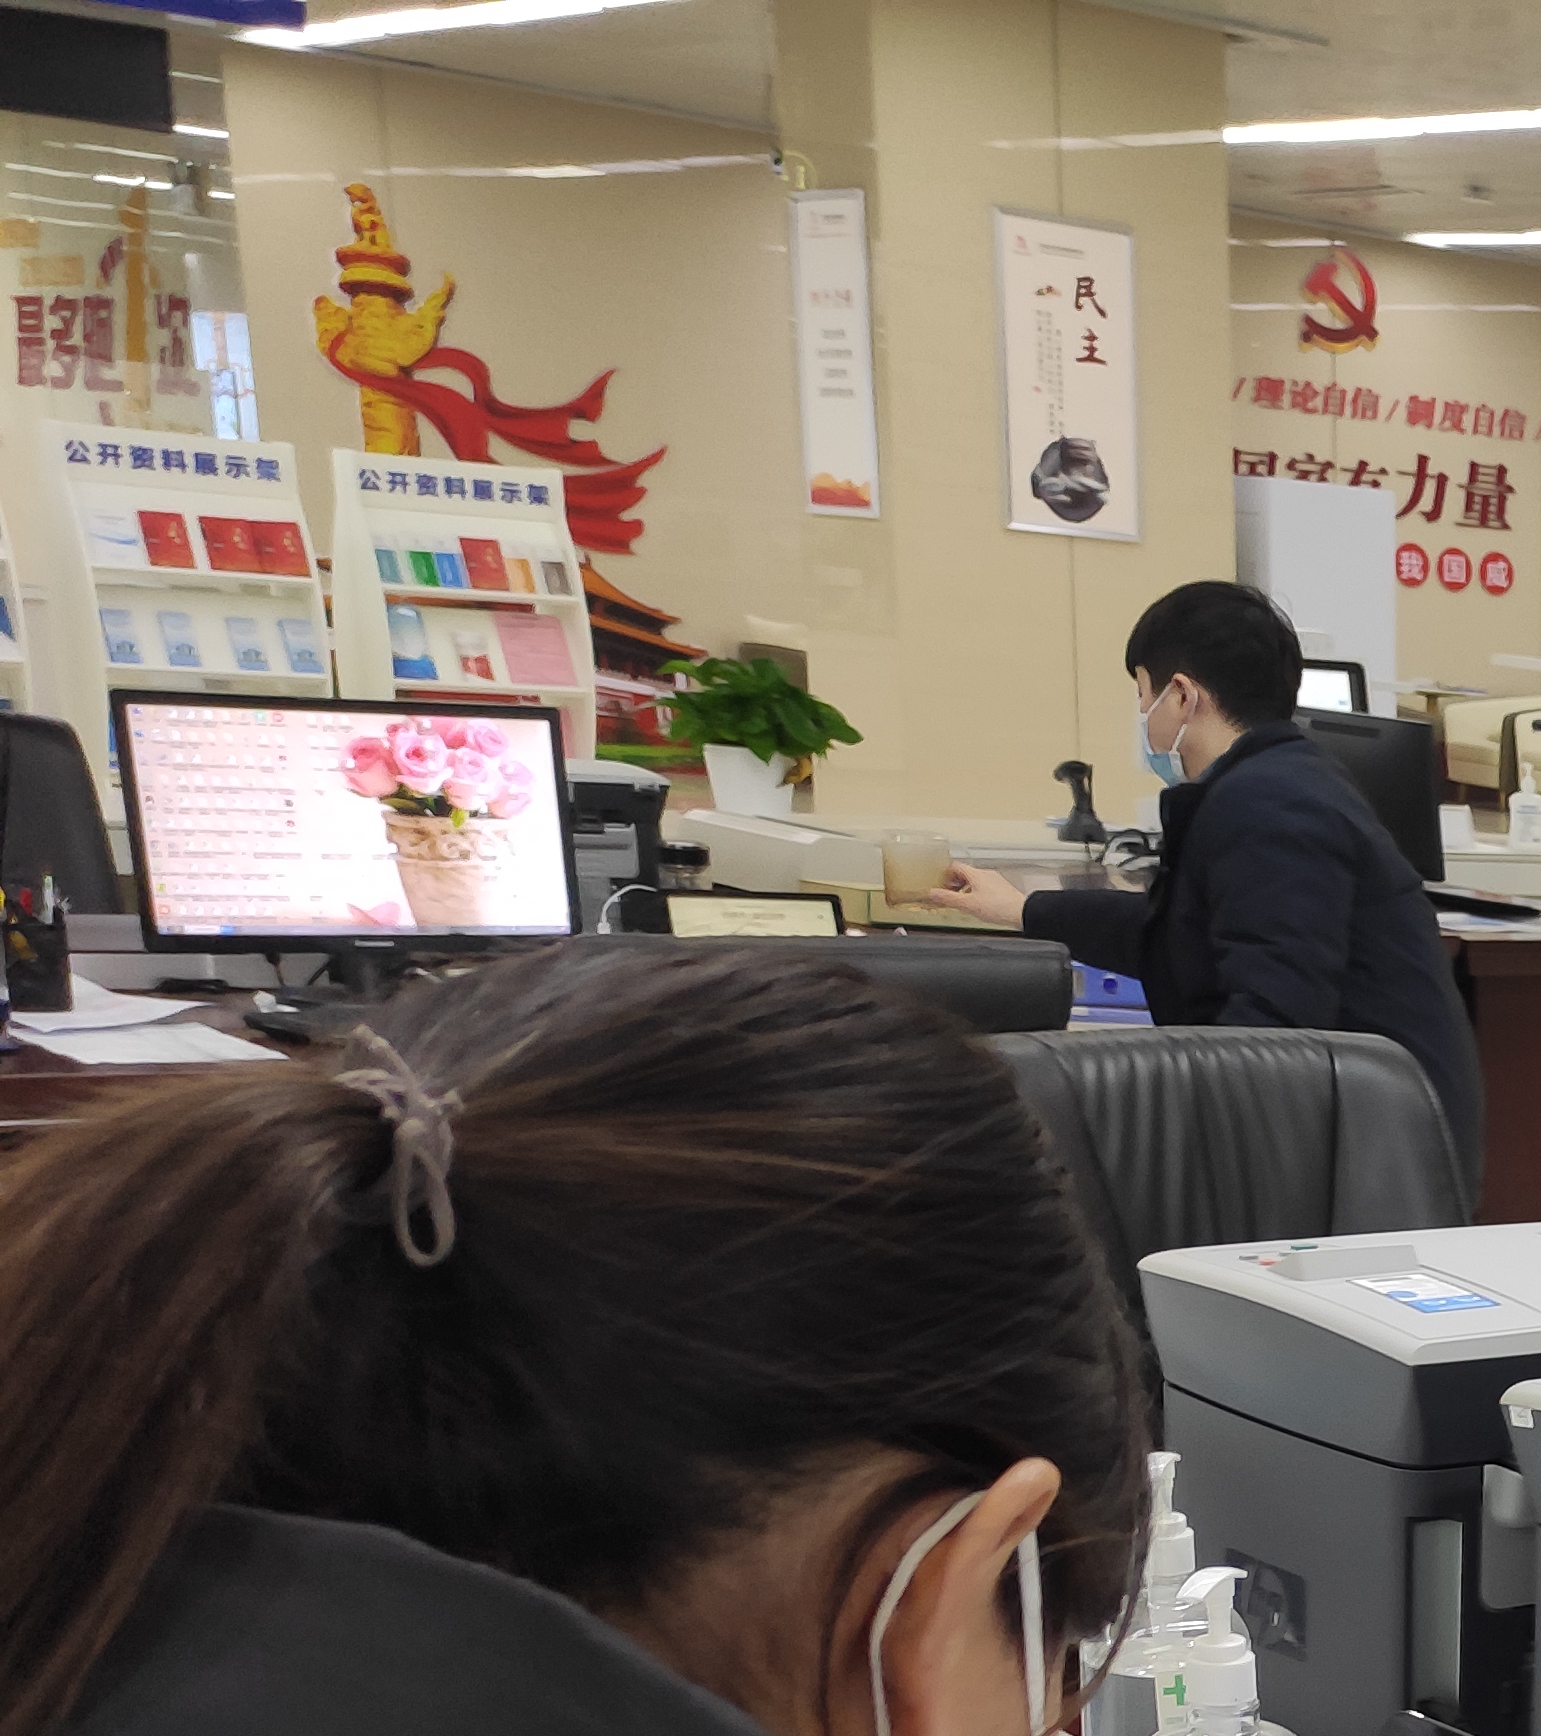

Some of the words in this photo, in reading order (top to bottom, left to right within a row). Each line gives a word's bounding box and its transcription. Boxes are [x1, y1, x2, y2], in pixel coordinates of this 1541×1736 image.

[1074, 275, 1108, 366] 民主
[64, 438, 282, 483] 公开资料展示架
